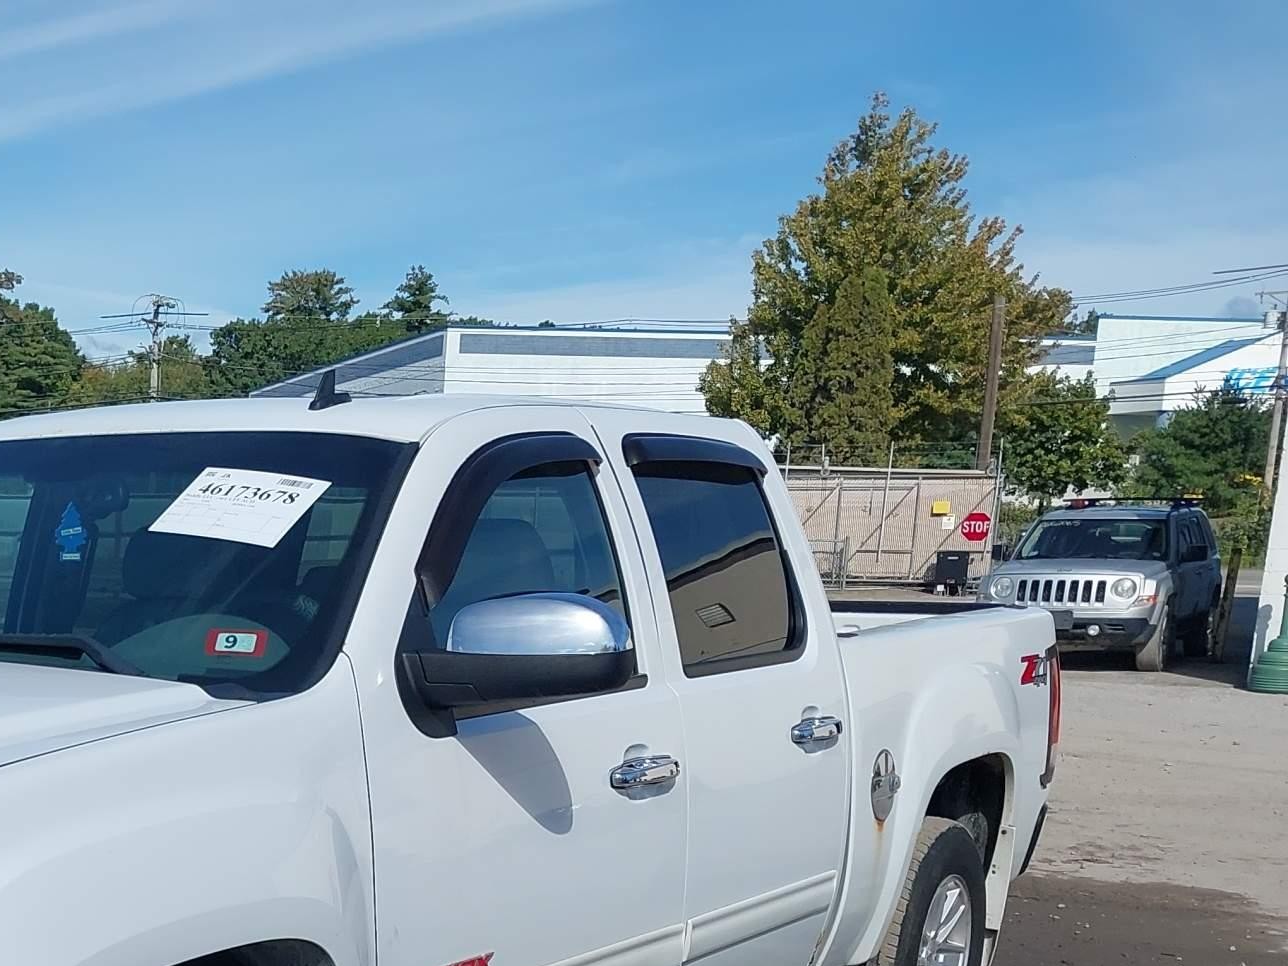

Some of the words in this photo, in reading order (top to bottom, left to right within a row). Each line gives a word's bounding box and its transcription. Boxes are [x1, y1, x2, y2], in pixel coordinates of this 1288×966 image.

[197, 482, 300, 505] 46173678
[962, 521, 991, 533] STOP
[224, 635, 238, 649] 9
